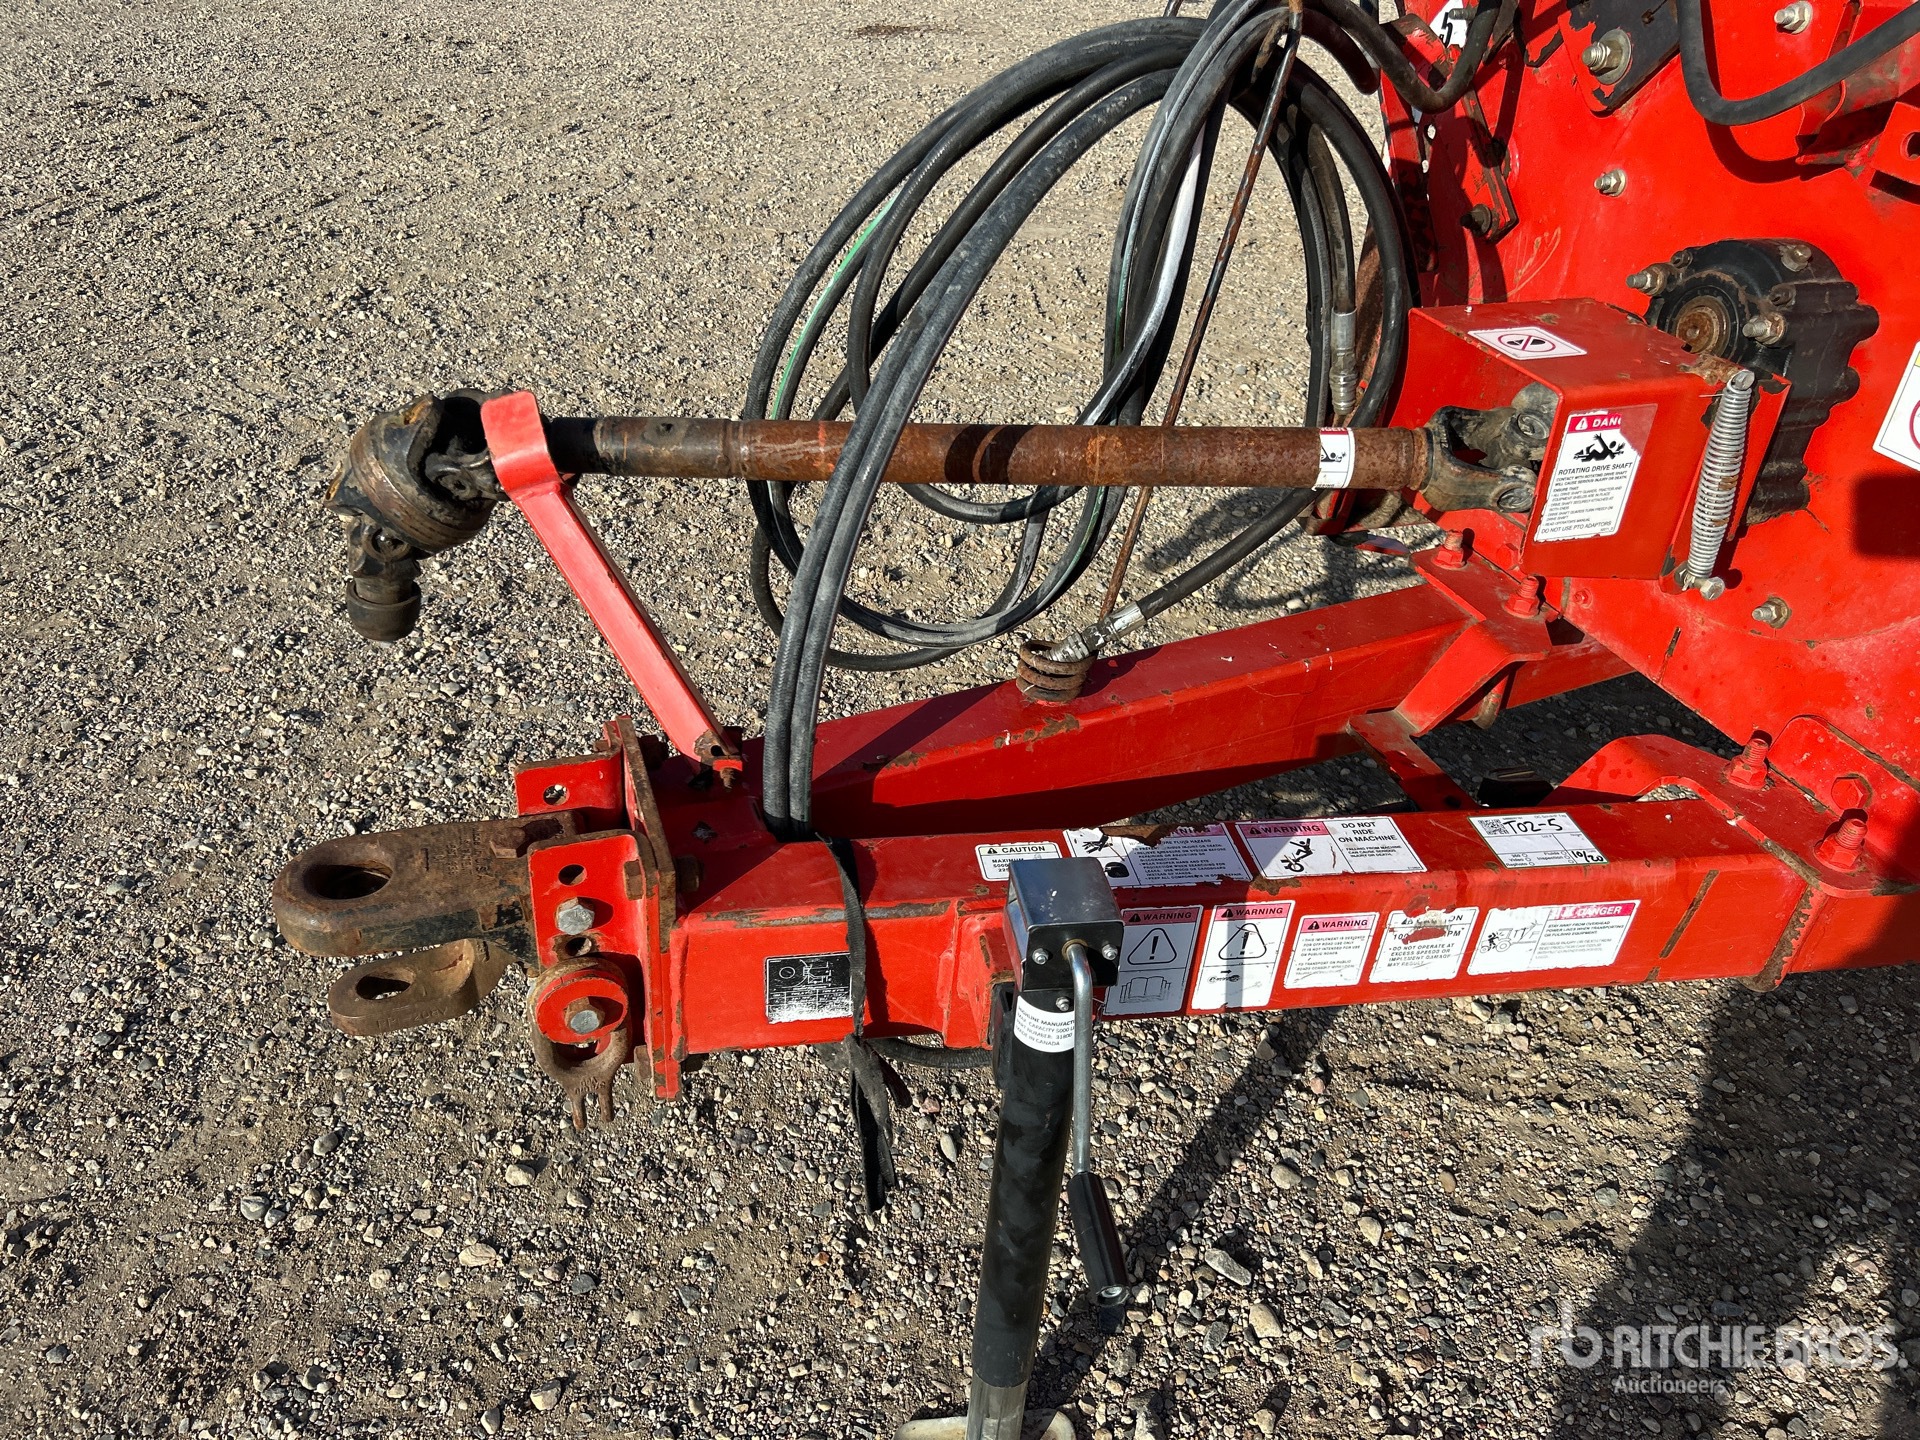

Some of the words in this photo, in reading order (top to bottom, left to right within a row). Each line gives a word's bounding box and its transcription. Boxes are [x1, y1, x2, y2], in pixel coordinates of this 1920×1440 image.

[1558, 467, 1590, 475] ROTATING
[1612, 462, 1632, 470] SHAFT
[1261, 824, 1321, 834] WARNING
[1503, 818, 1563, 834] T02-5
[1143, 911, 1192, 920] WARNING
[1236, 907, 1284, 916] WARNING
[1577, 906, 1622, 916] DANGER
[1322, 920, 1368, 928] WARNING
